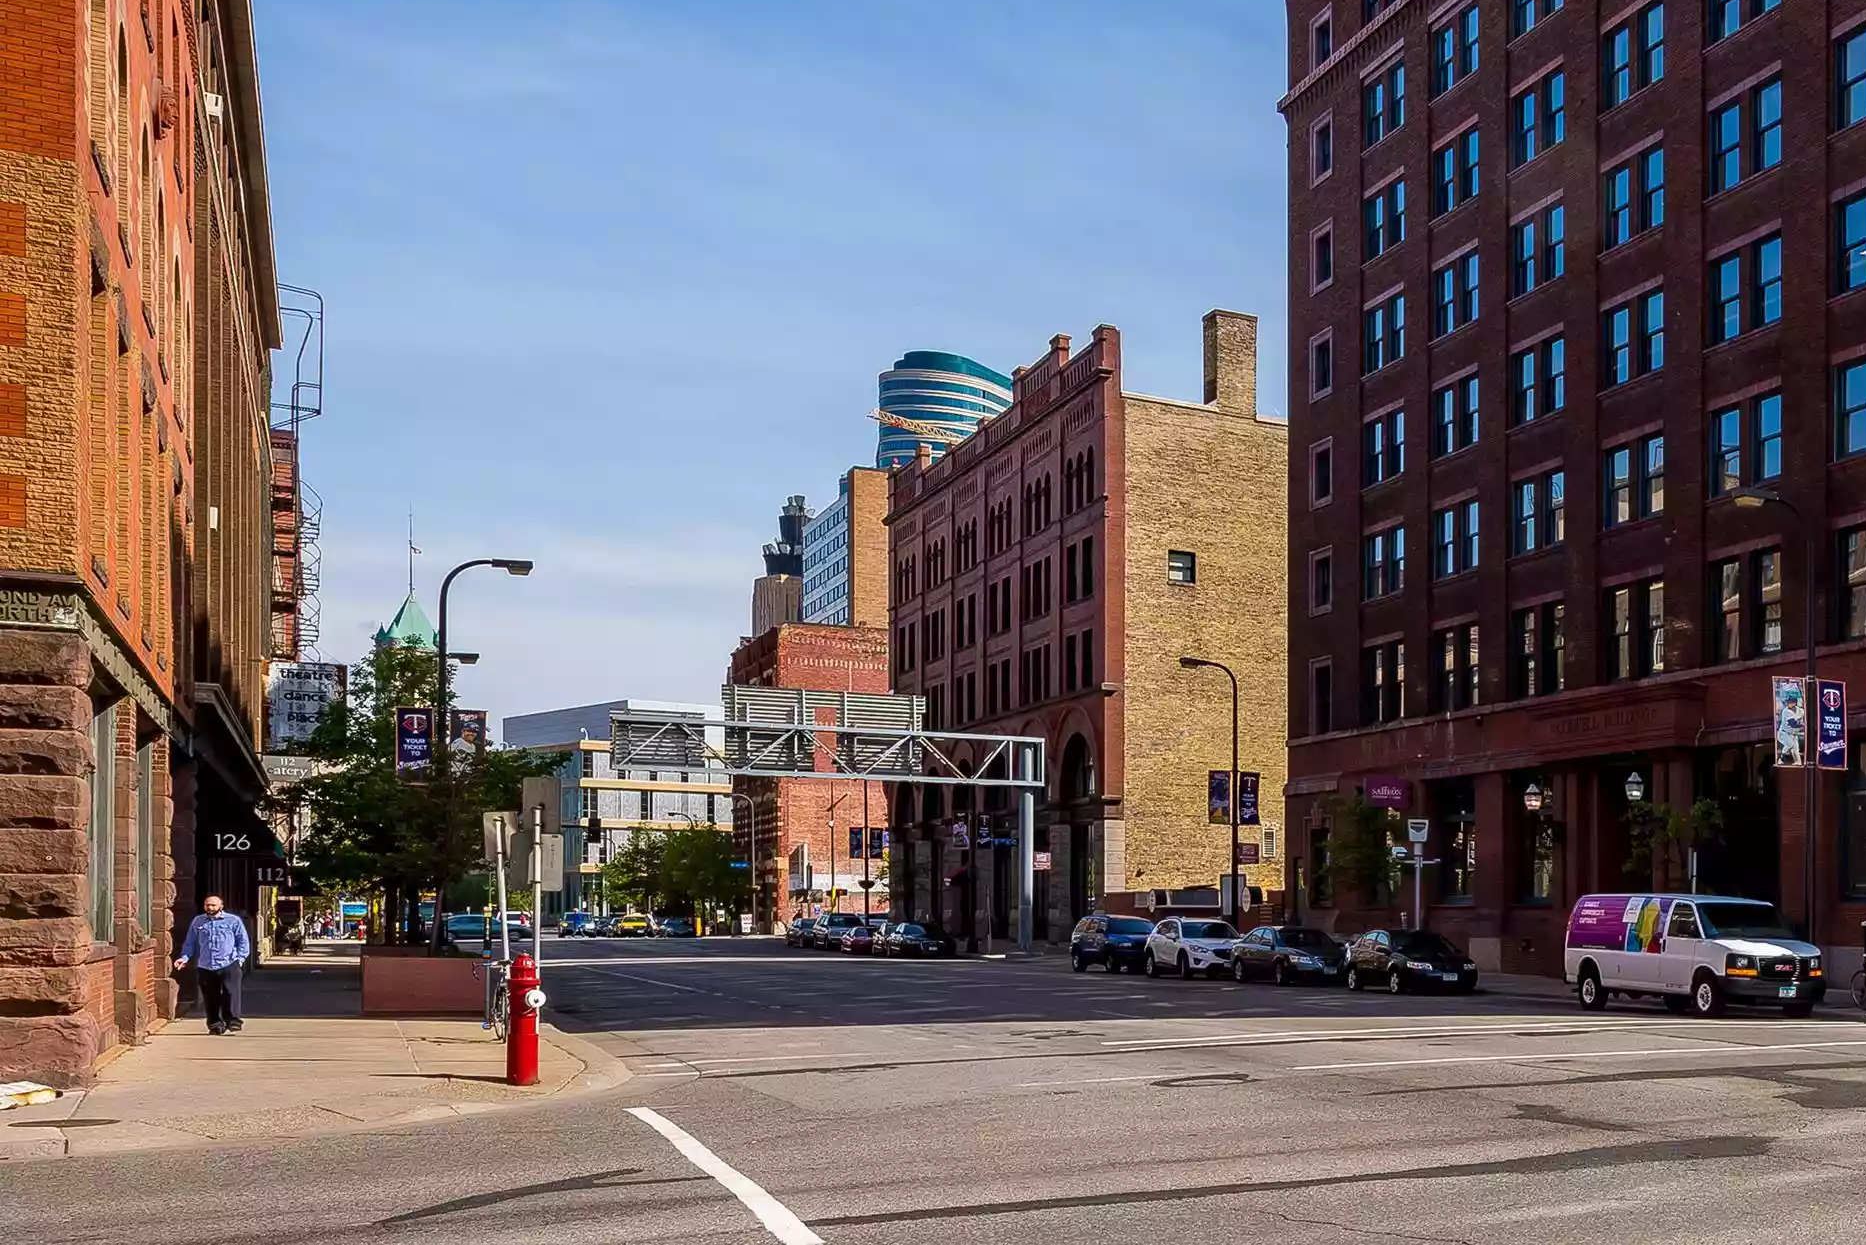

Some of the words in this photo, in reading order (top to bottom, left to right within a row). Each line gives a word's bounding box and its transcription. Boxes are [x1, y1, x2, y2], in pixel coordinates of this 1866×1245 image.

[279, 668, 334, 682] theatre
[283, 690, 328, 703] dance
[286, 711, 326, 725] place
[1823, 723, 1842, 731] TICKET
[280, 757, 297, 767] 112
[266, 767, 309, 779] eatery
[214, 833, 251, 851] 126
[256, 867, 285, 882] 112
